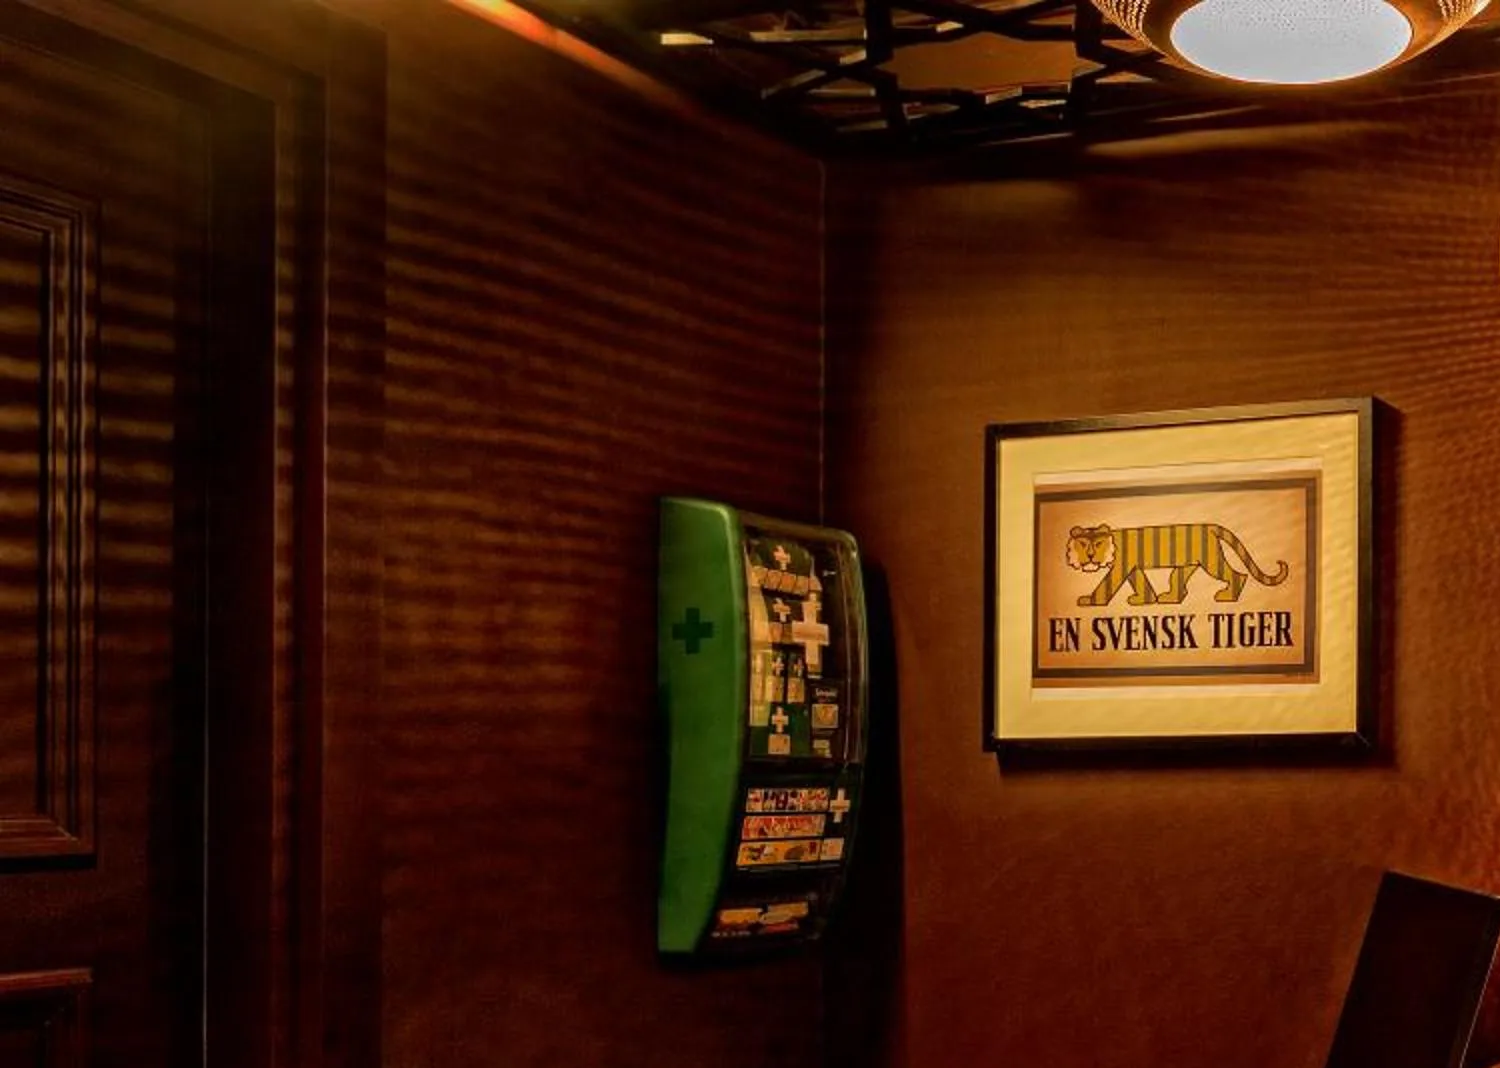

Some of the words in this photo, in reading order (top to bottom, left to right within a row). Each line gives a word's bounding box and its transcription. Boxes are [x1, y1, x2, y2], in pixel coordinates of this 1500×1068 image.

[1049, 617, 1081, 653] EN
[1091, 613, 1199, 651] SVENSK
[1208, 611, 1294, 649] TIGER
